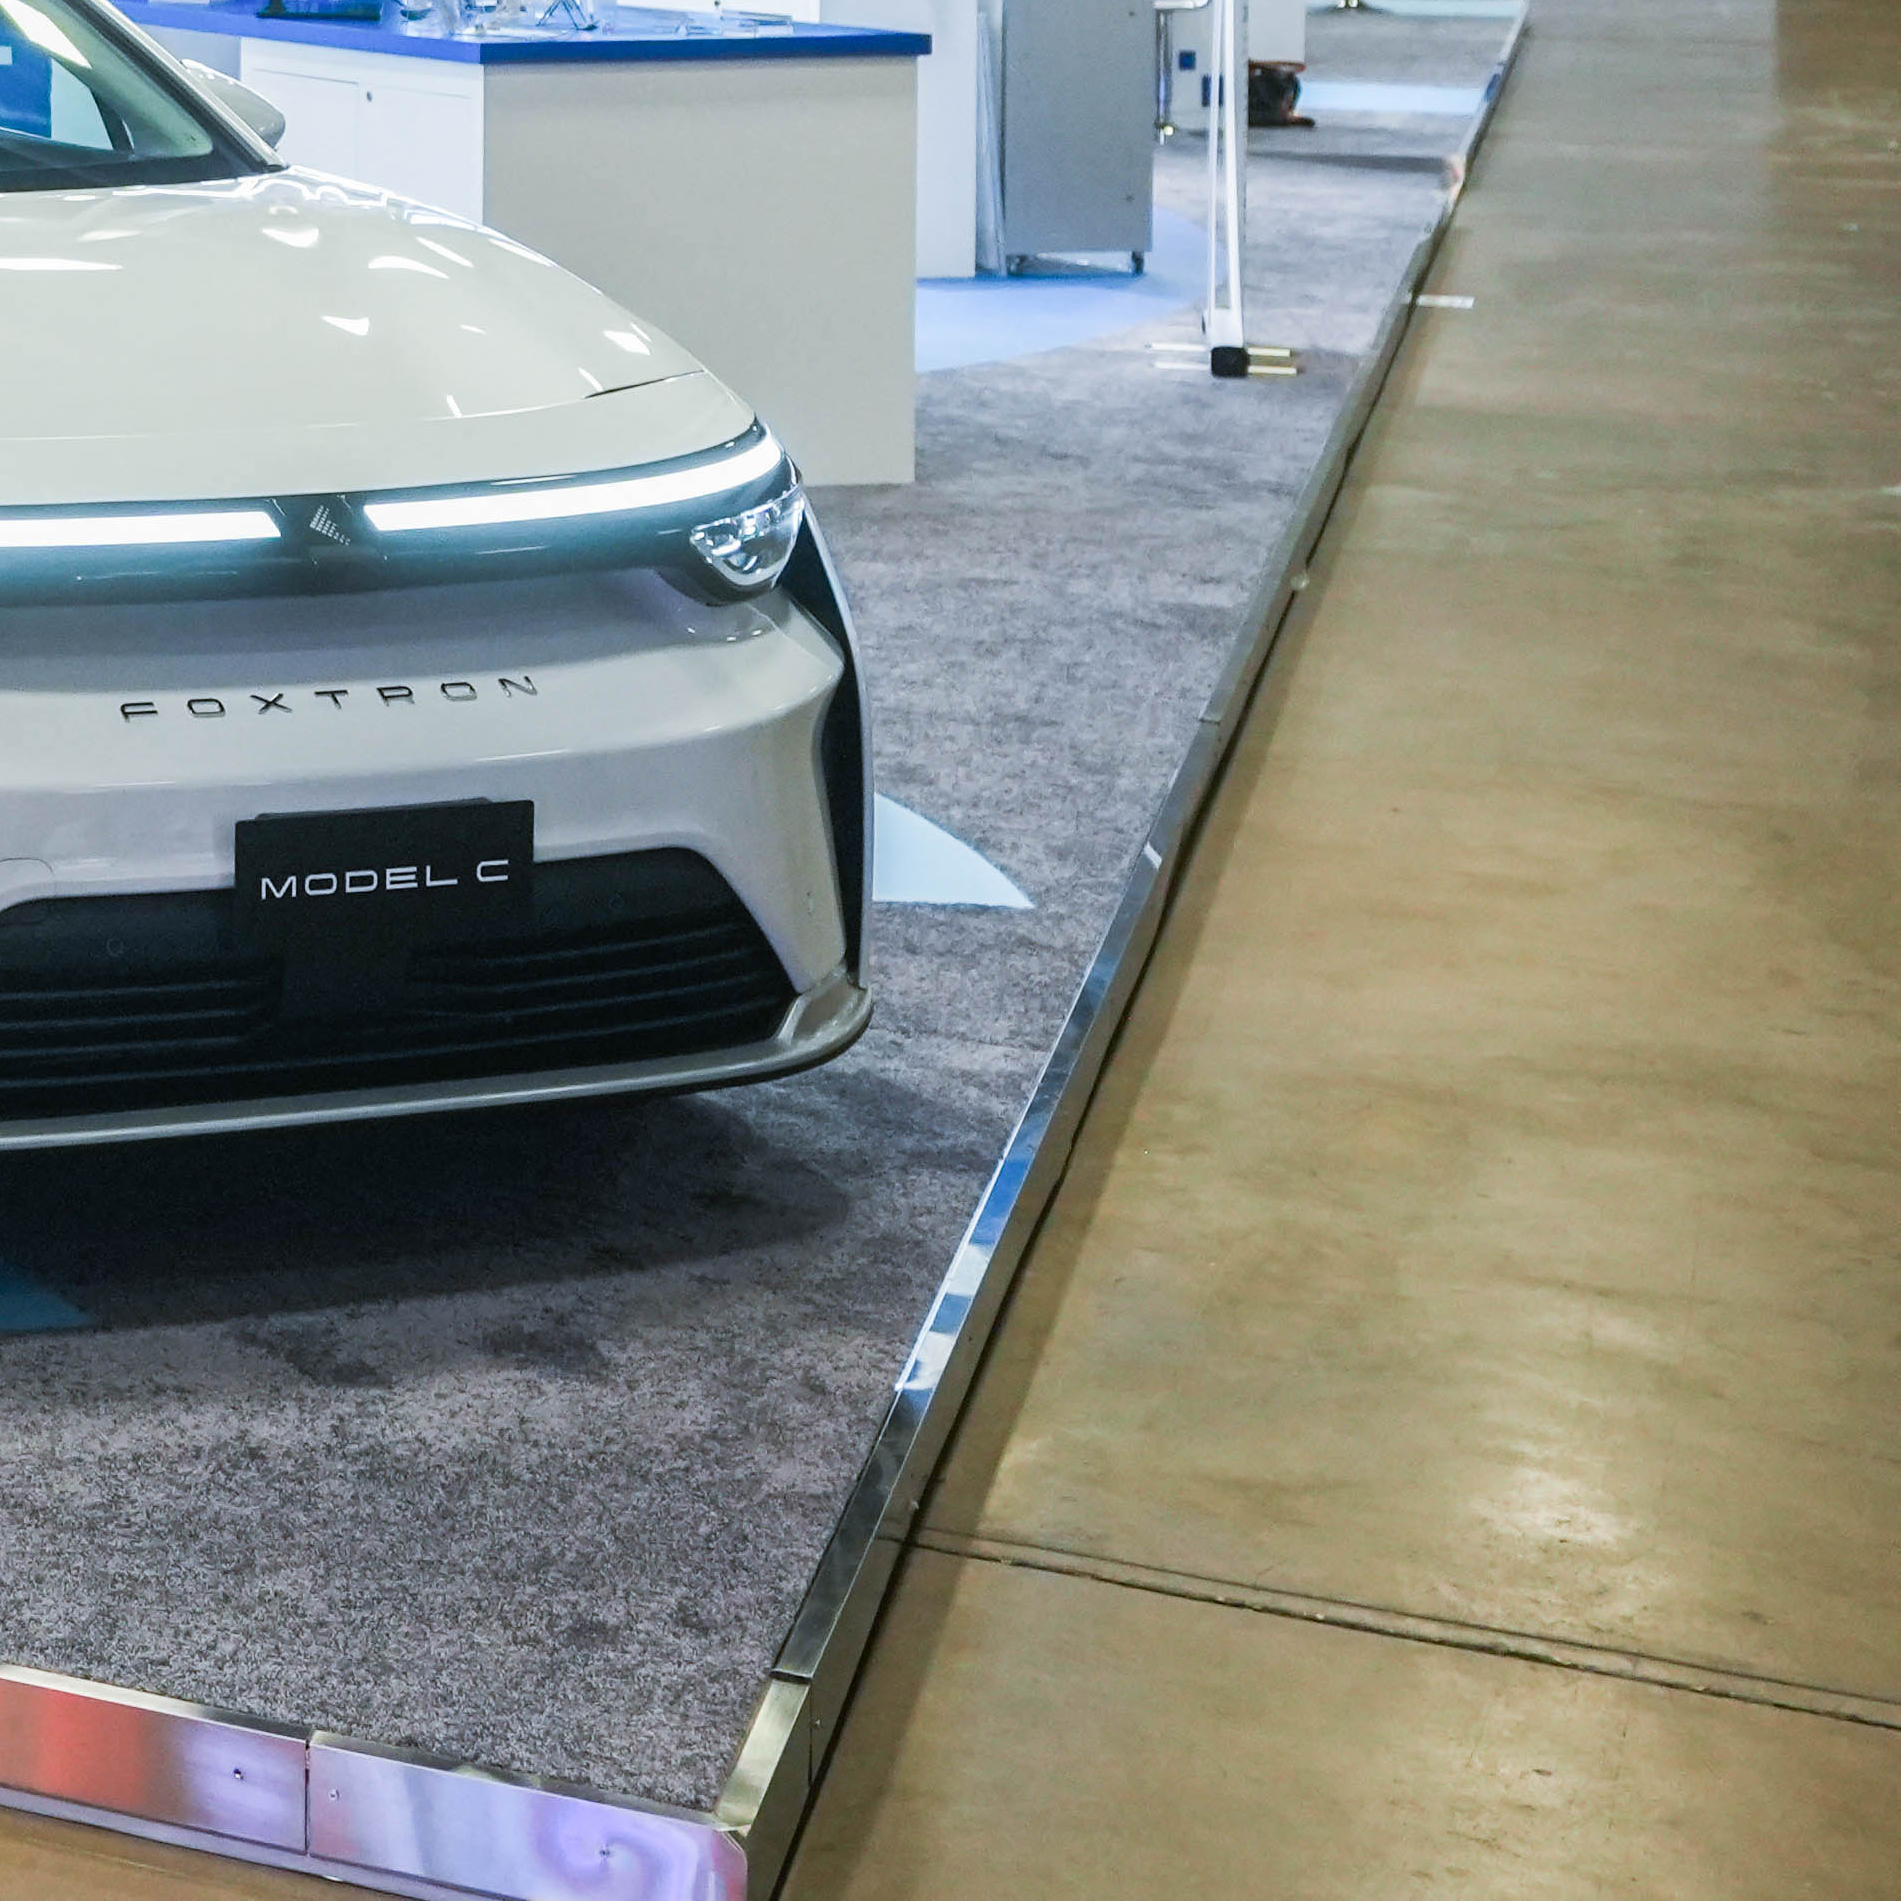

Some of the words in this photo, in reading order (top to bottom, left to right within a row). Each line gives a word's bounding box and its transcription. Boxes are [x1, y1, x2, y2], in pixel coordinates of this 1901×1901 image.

[120, 674, 539, 724] FOXTRON
[260, 864, 458, 901] MODEL
[475, 859, 510, 883] C
